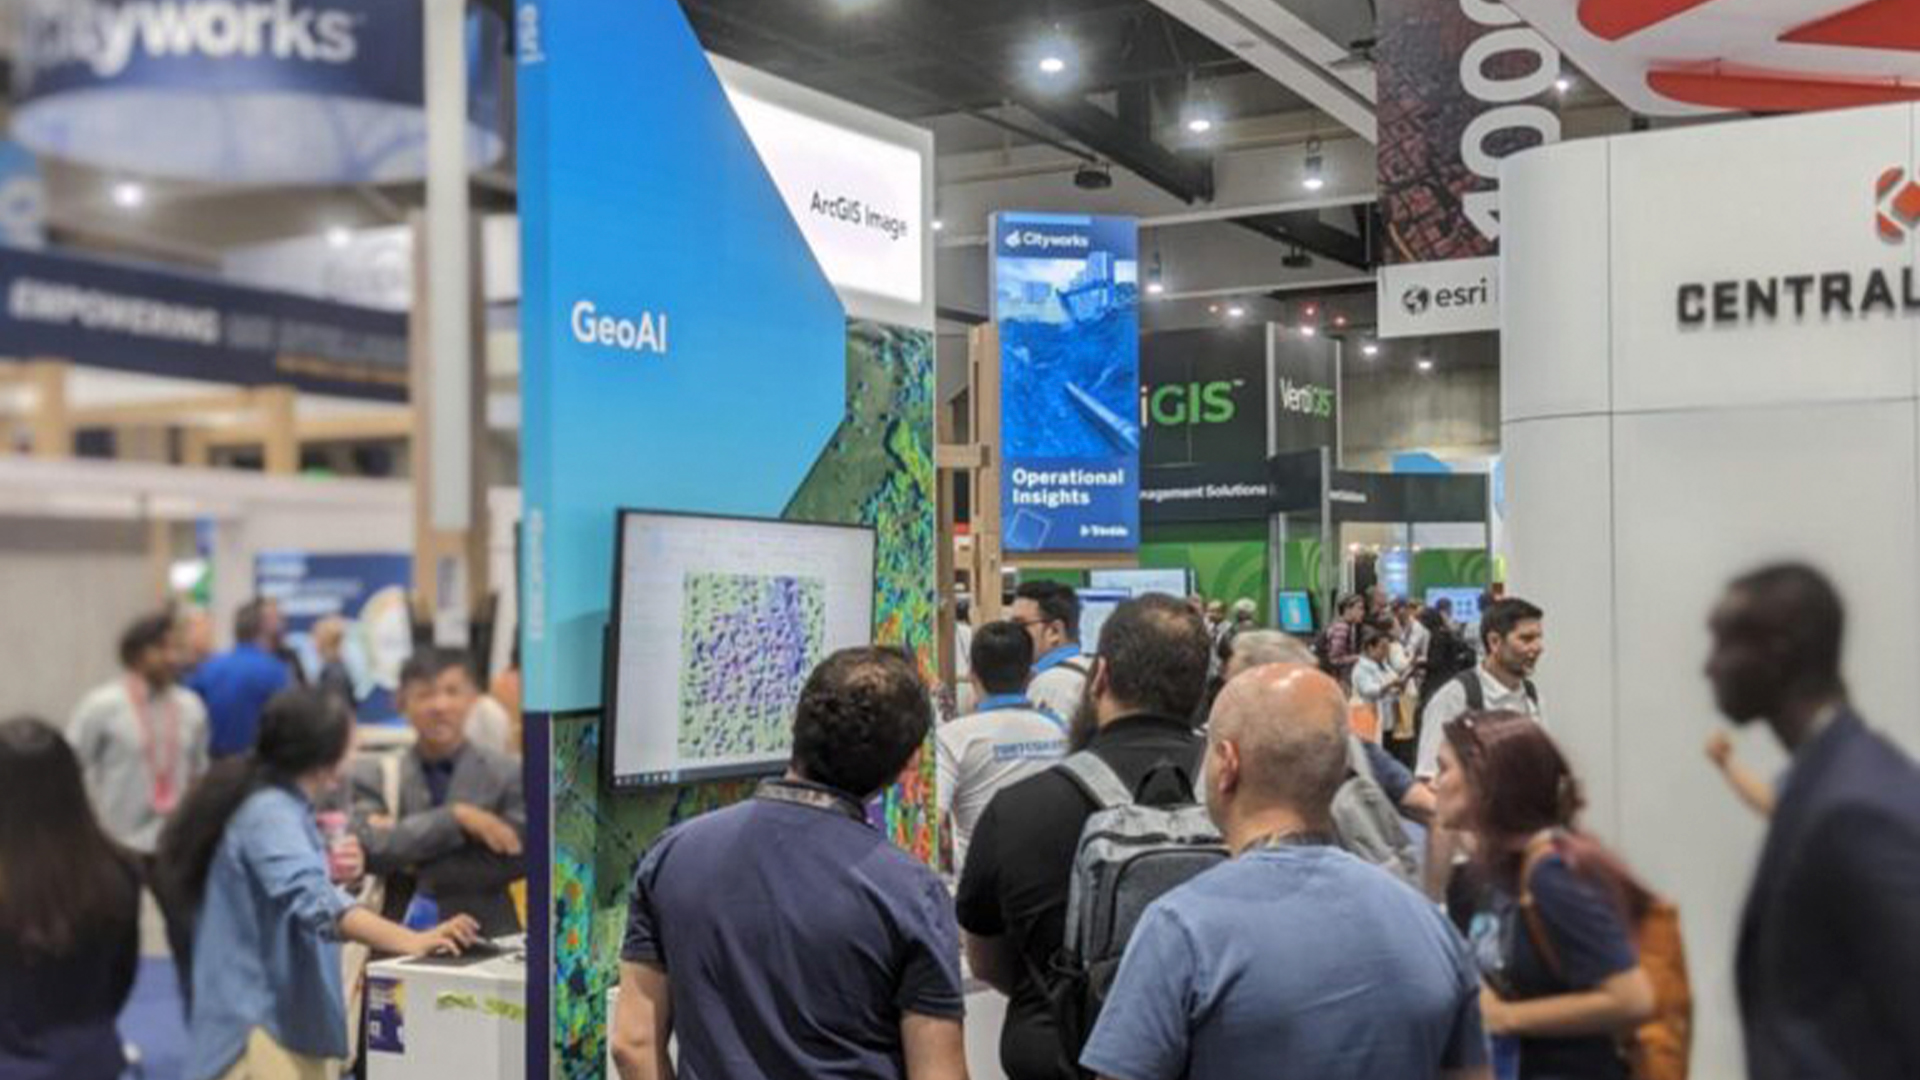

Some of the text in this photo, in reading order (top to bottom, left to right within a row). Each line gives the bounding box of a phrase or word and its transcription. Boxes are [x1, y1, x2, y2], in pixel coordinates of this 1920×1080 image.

[810, 190, 861, 225] ArcGIS
[1022, 231, 1090, 249] Cityworks
[1434, 276, 1487, 308] esri
[1677, 265, 1920, 326] CENTRAL
[570, 300, 668, 354] GeoAI
[1011, 467, 1126, 489] Operational
[1205, 481, 1268, 499] Solutions
[1011, 488, 1091, 509] Insights
